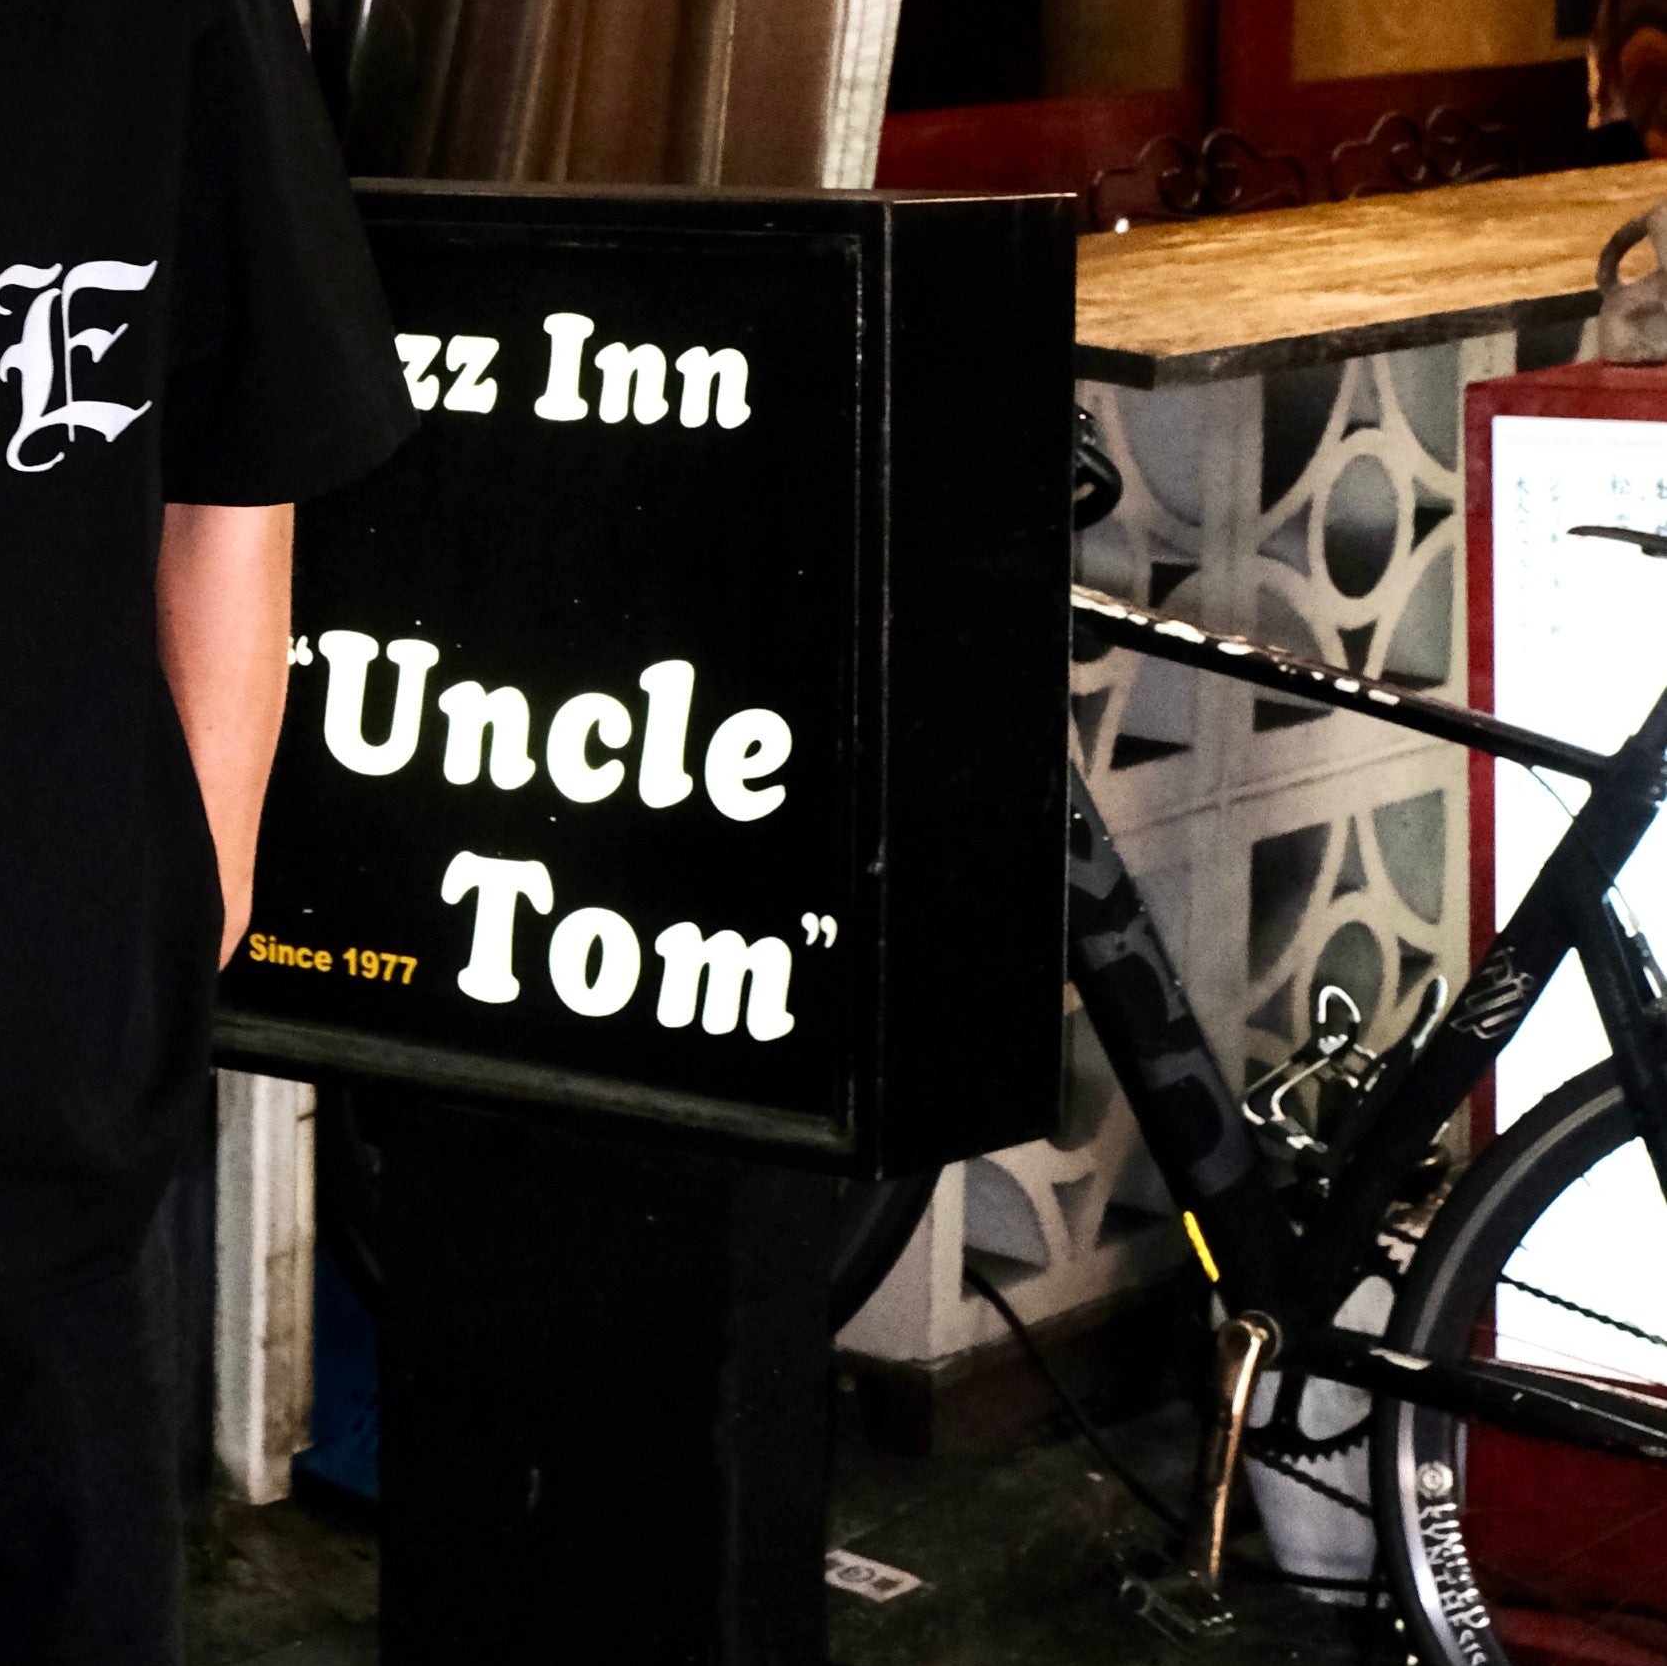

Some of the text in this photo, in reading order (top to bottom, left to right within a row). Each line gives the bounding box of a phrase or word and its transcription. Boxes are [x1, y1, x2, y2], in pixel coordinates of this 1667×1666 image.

[395, 313, 750, 429] zz Inn
[250, 934, 417, 984] Since 1977
